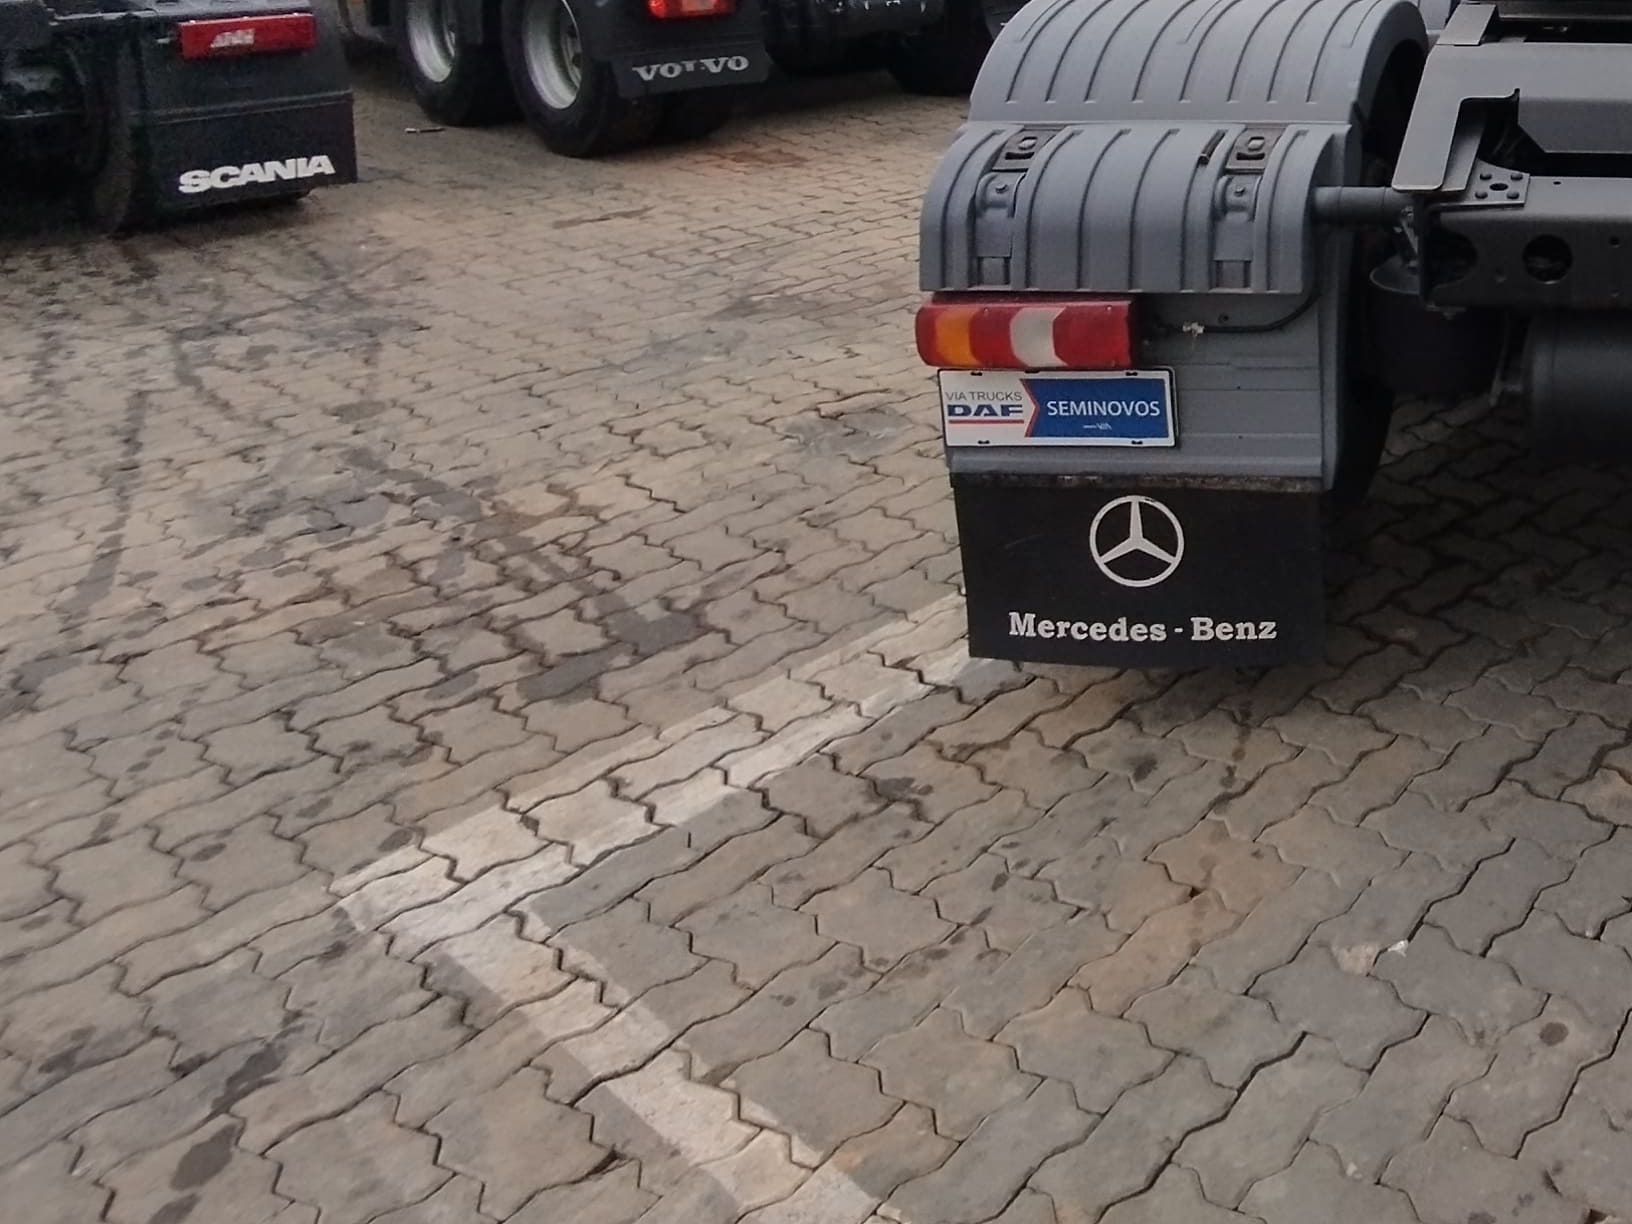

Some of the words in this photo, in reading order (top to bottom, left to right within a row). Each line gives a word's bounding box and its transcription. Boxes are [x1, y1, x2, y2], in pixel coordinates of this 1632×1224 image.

[178, 154, 336, 194] SCANIA
[945, 391, 968, 402] VIA
[970, 391, 1023, 402] TRUCKS
[947, 404, 1024, 418] DAF
[1046, 400, 1161, 417] SEMINOVOS
